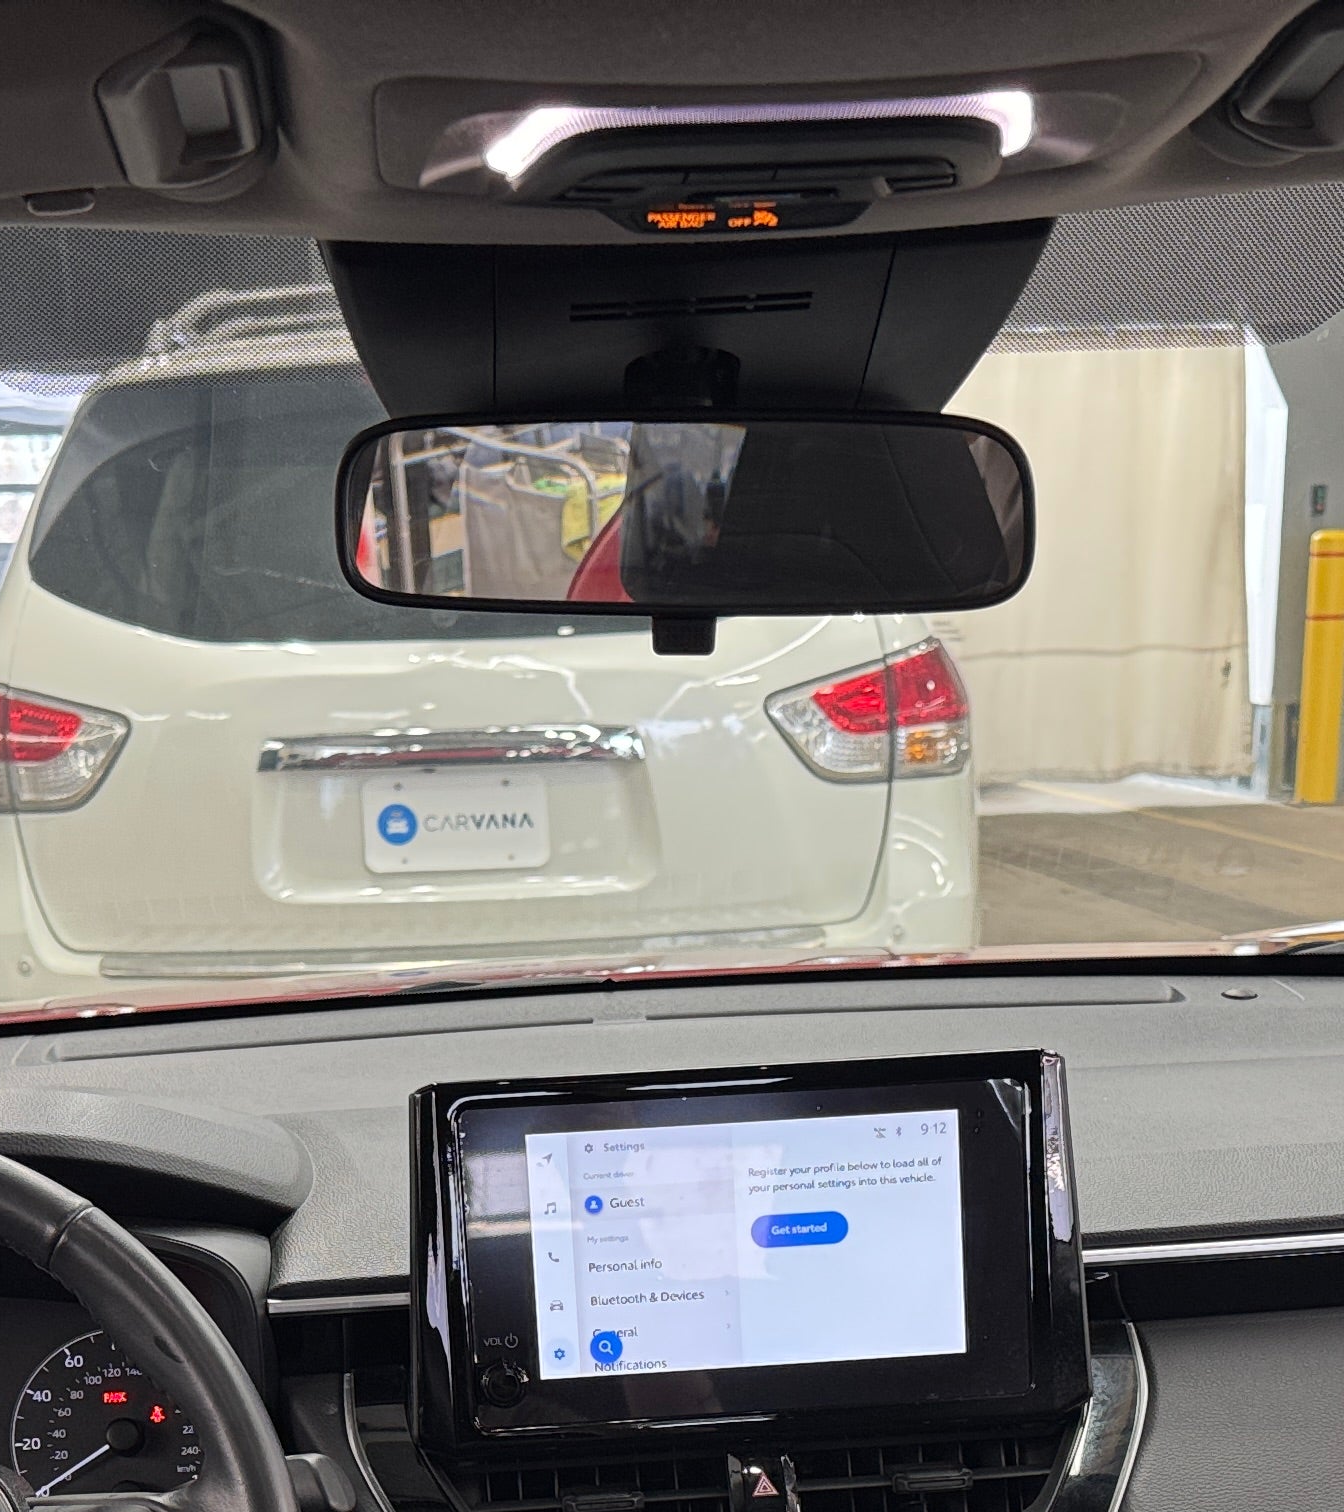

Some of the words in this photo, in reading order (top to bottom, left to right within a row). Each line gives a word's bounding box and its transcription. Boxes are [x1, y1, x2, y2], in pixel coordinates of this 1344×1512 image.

[728, 217, 752, 228] OFF
[422, 812, 535, 832] CARVANA
[603, 1142, 646, 1154] Settings
[748, 1167, 788, 1179] Register
[789, 1166, 811, 1178] your
[813, 1163, 846, 1176] profile
[847, 1160, 878, 1172] below
[879, 1159, 891, 1169] to
[892, 1158, 915, 1168] load
[917, 1157, 929, 1167] all
[931, 1156, 942, 1166] of
[748, 1184, 770, 1196] your
[772, 1181, 816, 1194] personal
[817, 1178, 856, 1191] settings
[858, 1176, 877, 1187] into
[879, 1175, 898, 1185] this
[898, 1173, 937, 1184] vehicle.
[609, 1197, 646, 1209] Guest
[770, 1225, 791, 1236] Get
[792, 1222, 828, 1234] started
[588, 1259, 639, 1273] Personal
[640, 1258, 663, 1270] info
[590, 1292, 647, 1307] Bluetooth
[649, 1292, 658, 1302] &
[660, 1290, 705, 1302] Devices
[592, 1326, 639, 1338] Geral
[483, 1337, 503, 1347] VOL
[64, 1355, 84, 1368] 60
[594, 1359, 668, 1373] Notifications
[102, 1368, 121, 1378] 120
[84, 1375, 102, 1385] 100
[32, 1389, 52, 1402] 40
[69, 1390, 84, 1400] 80
[103, 1391, 128, 1404] PARK
[57, 1407, 72, 1417] 60
[52, 1429, 66, 1439] 40
[22, 1437, 41, 1450] 20
[54, 1450, 69, 1460] 20
[181, 1446, 199, 1456] 240
